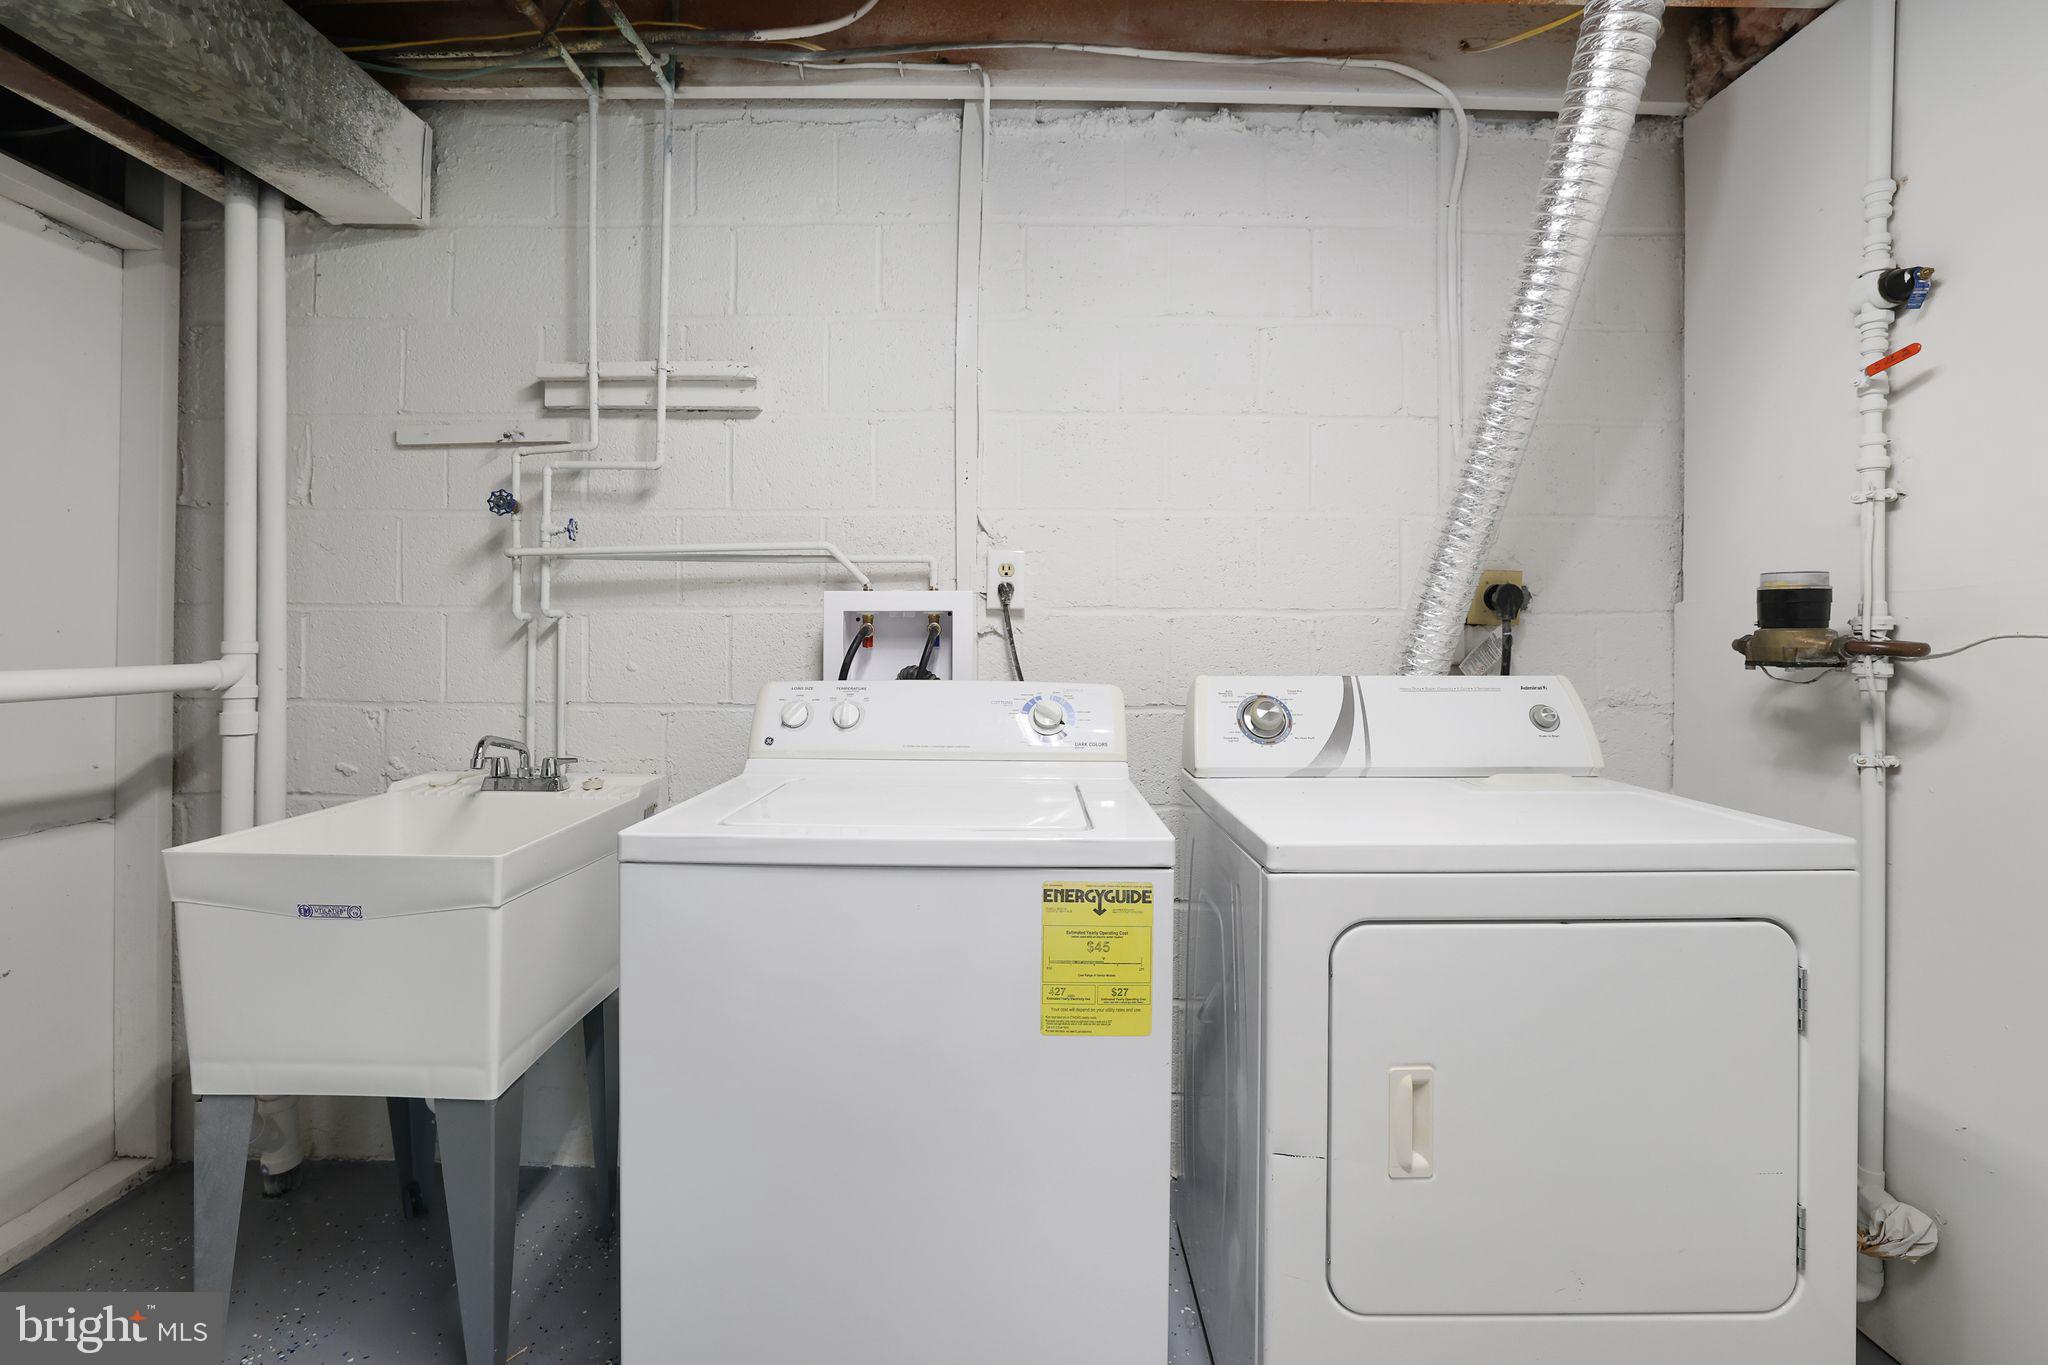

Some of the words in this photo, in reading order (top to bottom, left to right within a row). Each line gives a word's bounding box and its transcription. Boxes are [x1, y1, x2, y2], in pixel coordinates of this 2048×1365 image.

[1043, 888, 1152, 905] ENERGYGUIDE
[1086, 940, 1111, 953] $45
[1111, 987, 1129, 997] $27
